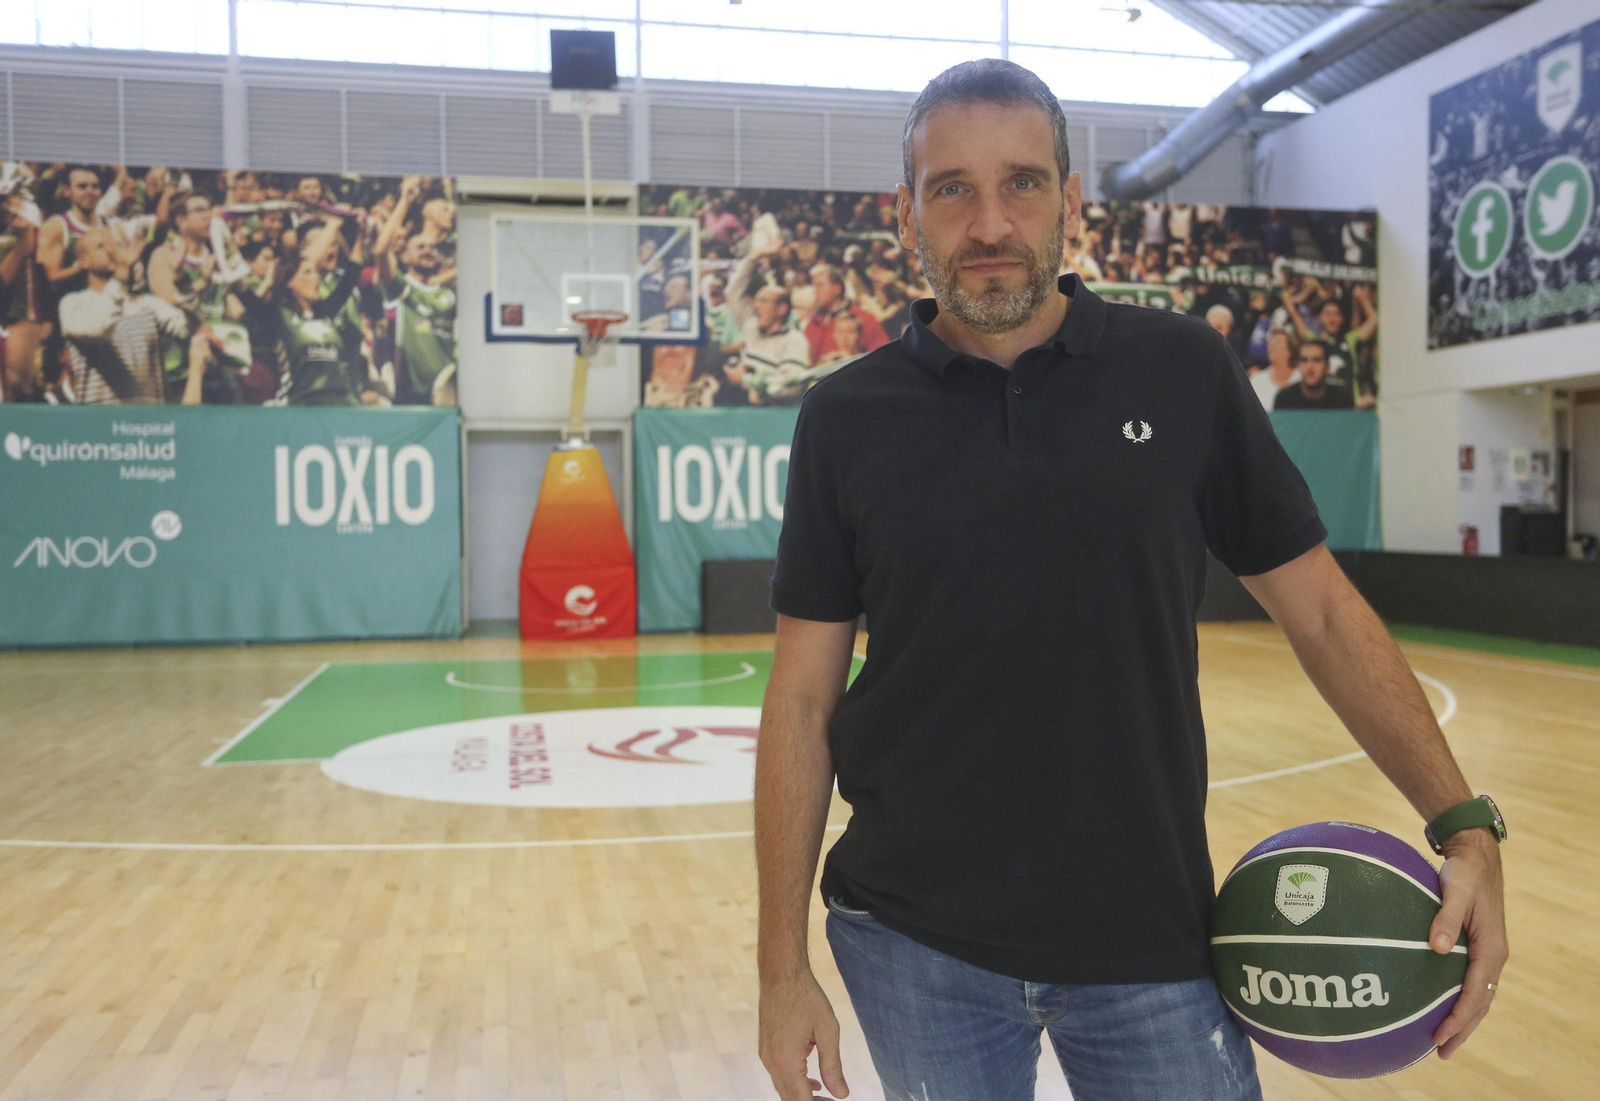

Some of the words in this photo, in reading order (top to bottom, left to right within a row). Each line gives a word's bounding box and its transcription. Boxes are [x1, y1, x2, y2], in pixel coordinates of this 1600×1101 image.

[113, 422, 175, 436] Hospital
[14, 537, 156, 568] ANOVO
[1284, 890, 1314, 901] Unicaja
[1240, 964, 1389, 1008] Joma
